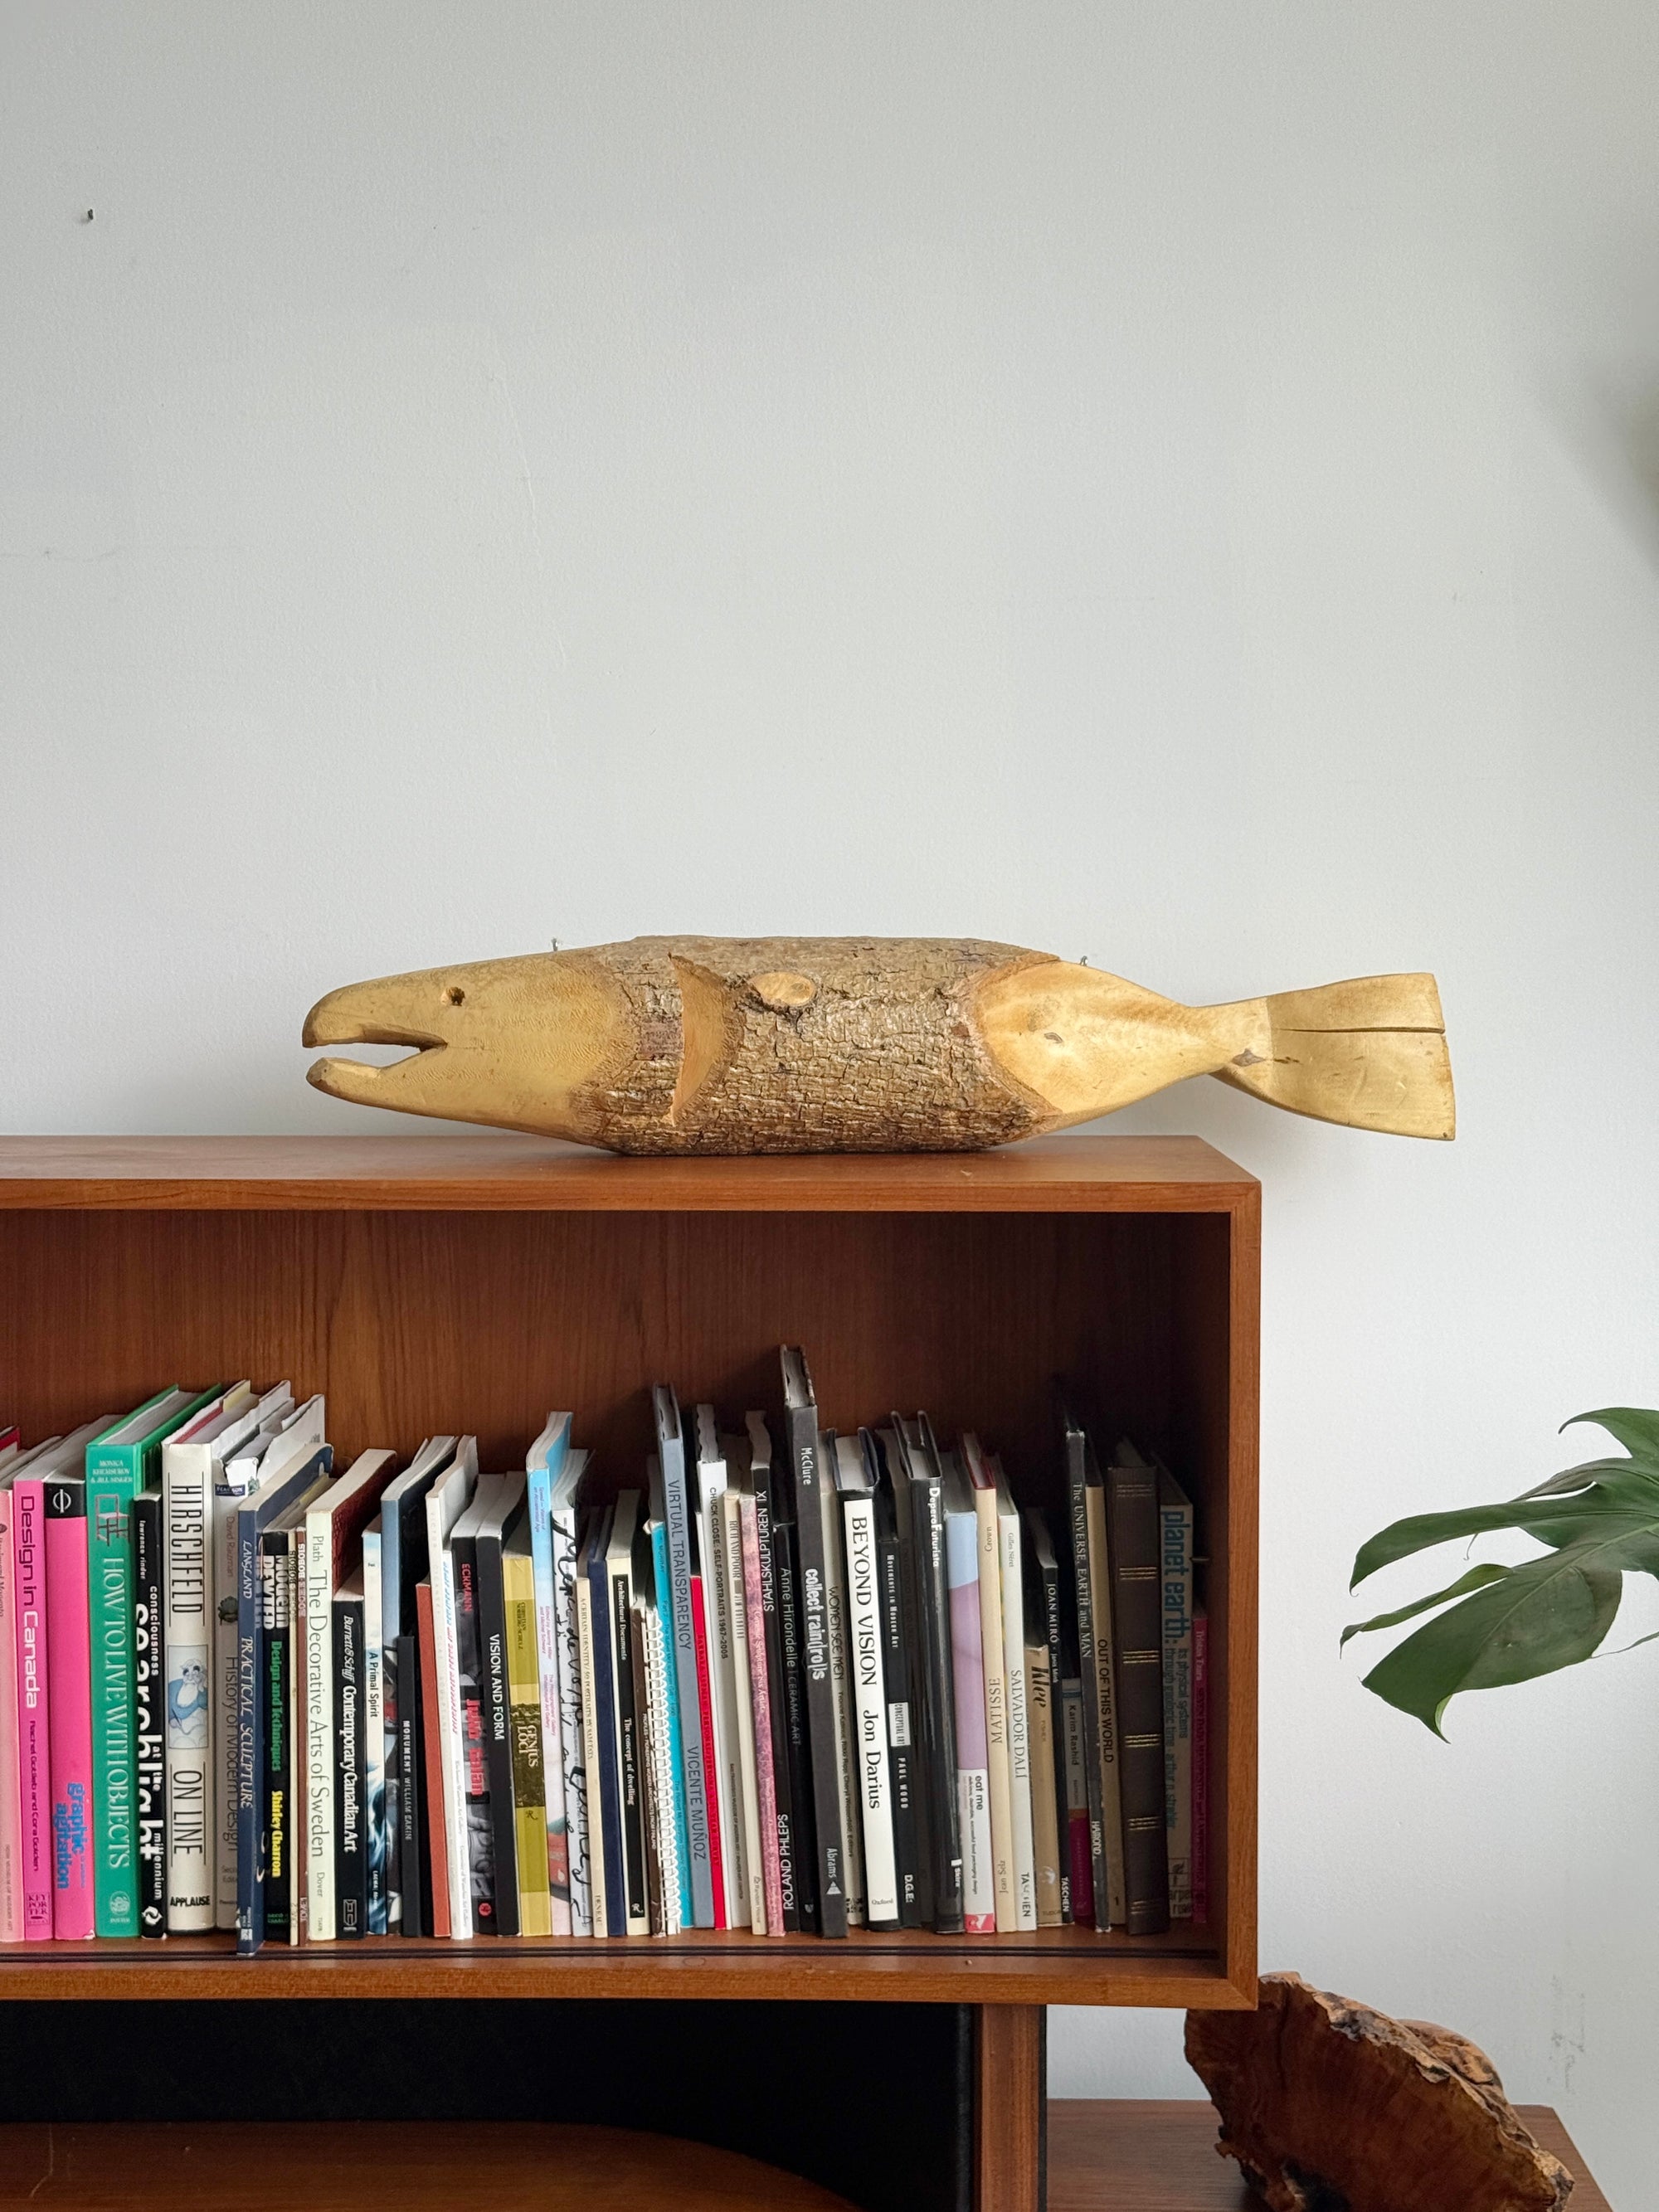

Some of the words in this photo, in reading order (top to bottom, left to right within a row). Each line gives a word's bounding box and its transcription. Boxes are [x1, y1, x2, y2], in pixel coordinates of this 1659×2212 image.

[801, 1447, 813, 1485] McClure
[668, 1481, 682, 1537] VIRTUAL
[709, 1488, 718, 1516] CHUCK
[757, 1491, 767, 1502] IX
[1073, 1483, 1082, 1500] The
[19, 1496, 36, 1580] Design
[226, 1517, 235, 1539] David
[711, 1518, 720, 1547] CLOSE:
[1074, 1505, 1087, 1564] UNIVERSE,
[1162, 1511, 1190, 1576] planet
[171, 1485, 203, 1613] HIRSCHFELD
[312, 1536, 324, 1562] Plath
[732, 1556, 741, 1578] POOR
[758, 1509, 774, 1611] STAHLSKULPTUREN
[852, 1517, 872, 1605] BEYOND
[104, 1558, 125, 1610] HOW
[243, 1540, 252, 1598] LANGLAND
[461, 1564, 472, 1611] ECKMANN
[715, 1549, 724, 1616] SELF-PORTRAITS
[780, 1568, 791, 1599] Anne
[1077, 1568, 1088, 1605] EARTH
[23, 1586, 37, 1605] in
[309, 1570, 328, 1608] The
[617, 1580, 626, 1622] Architectural
[673, 1541, 691, 1650] TRANSPARENCY
[805, 1569, 823, 1611] collect
[1046, 1584, 1056, 1610] JOAN
[828, 1586, 840, 1631] WOMEN
[1080, 1610, 1090, 1627] and
[1165, 1582, 1189, 1644] earth:
[104, 1613, 126, 1648] TO
[150, 1586, 160, 1675] consciousness
[783, 1604, 797, 1667] Hirondelle
[831, 1633, 842, 1653] SEE
[1049, 1614, 1059, 1642] MIRÓ
[1081, 1633, 1091, 1657] MAN
[23, 1611, 40, 1709] Canada
[270, 1641, 282, 1680] Design
[309, 1615, 328, 1714] Decorative
[489, 1634, 502, 1673] VISION
[833, 1657, 844, 1680] MEN
[858, 1615, 877, 1685] VISION
[1098, 1639, 1107, 1663] OUT
[104, 1650, 127, 1701] LIVE
[221, 1656, 239, 1709] History
[241, 1636, 254, 1716] PRACTICAL
[271, 1682, 282, 1705] and
[370, 1662, 379, 1690] Primal
[491, 1677, 503, 1702] AND
[1031, 1666, 1049, 1707] Klee
[1100, 1668, 1109, 1684] OF
[1176, 1661, 1189, 1698] physical
[368, 1693, 380, 1717] Spirit
[788, 1677, 800, 1722] CERAMIC
[989, 1678, 1002, 1743] MATISSE
[1011, 1670, 1024, 1743] SALVADOR
[1069, 1705, 1077, 1731] Karim
[1101, 1687, 1112, 1714] THIS
[104, 1705, 129, 1767] WITH
[227, 1715, 238, 1733] of
[339, 1685, 357, 1771] Contemporary
[493, 1706, 505, 1740] FORM
[792, 1726, 800, 1745] ART
[863, 1710, 878, 1741] Jon
[894, 1704, 905, 1734] CONCEPTUAL
[1176, 1700, 1190, 1738] systems
[271, 1707, 283, 1771] Techniques
[310, 1720, 327, 1757] Arts
[517, 1726, 528, 1754] LOCI
[527, 1725, 540, 1767] GENIUS
[624, 1734, 633, 1761] concept
[896, 1736, 905, 1745] ART
[1070, 1735, 1079, 1765] Rashid
[1102, 1719, 1114, 1763] WORLD
[227, 1735, 238, 1793] Modern
[240, 1723, 253, 1809] SCULPTURE
[311, 1763, 329, 1780] of
[687, 1746, 701, 1805] VICENTE
[866, 1752, 882, 1809] Darius
[898, 1757, 906, 1779] PAUL
[1015, 1747, 1027, 1778] DALÍ
[173, 1771, 202, 1799] ON
[344, 1772, 358, 1829] Canadian
[625, 1774, 635, 1805] dwelling
[899, 1784, 909, 1809] WOOD
[975, 1776, 983, 1792] eat
[976, 1794, 984, 1810] me
[68, 1783, 87, 1854] graphic
[106, 1768, 130, 1868] OBJECTS
[222, 1799, 238, 1851] Design
[271, 1791, 283, 1829] Shirley
[311, 1788, 329, 1857] Sweden
[54, 1803, 72, 1889] agitation
[174, 1811, 203, 1854] LINE
[344, 1831, 357, 1852] Art
[691, 1810, 706, 1861] MUÑOZ
[778, 1815, 789, 1855] PHLEPS
[271, 1831, 282, 1877] Charron
[827, 1848, 838, 1878] Abrams
[170, 1896, 210, 1905] APPLAUSE
[316, 1872, 325, 1897] Dover
[780, 1860, 794, 1910] ROLAND
[999, 1879, 1007, 1893] Jean
